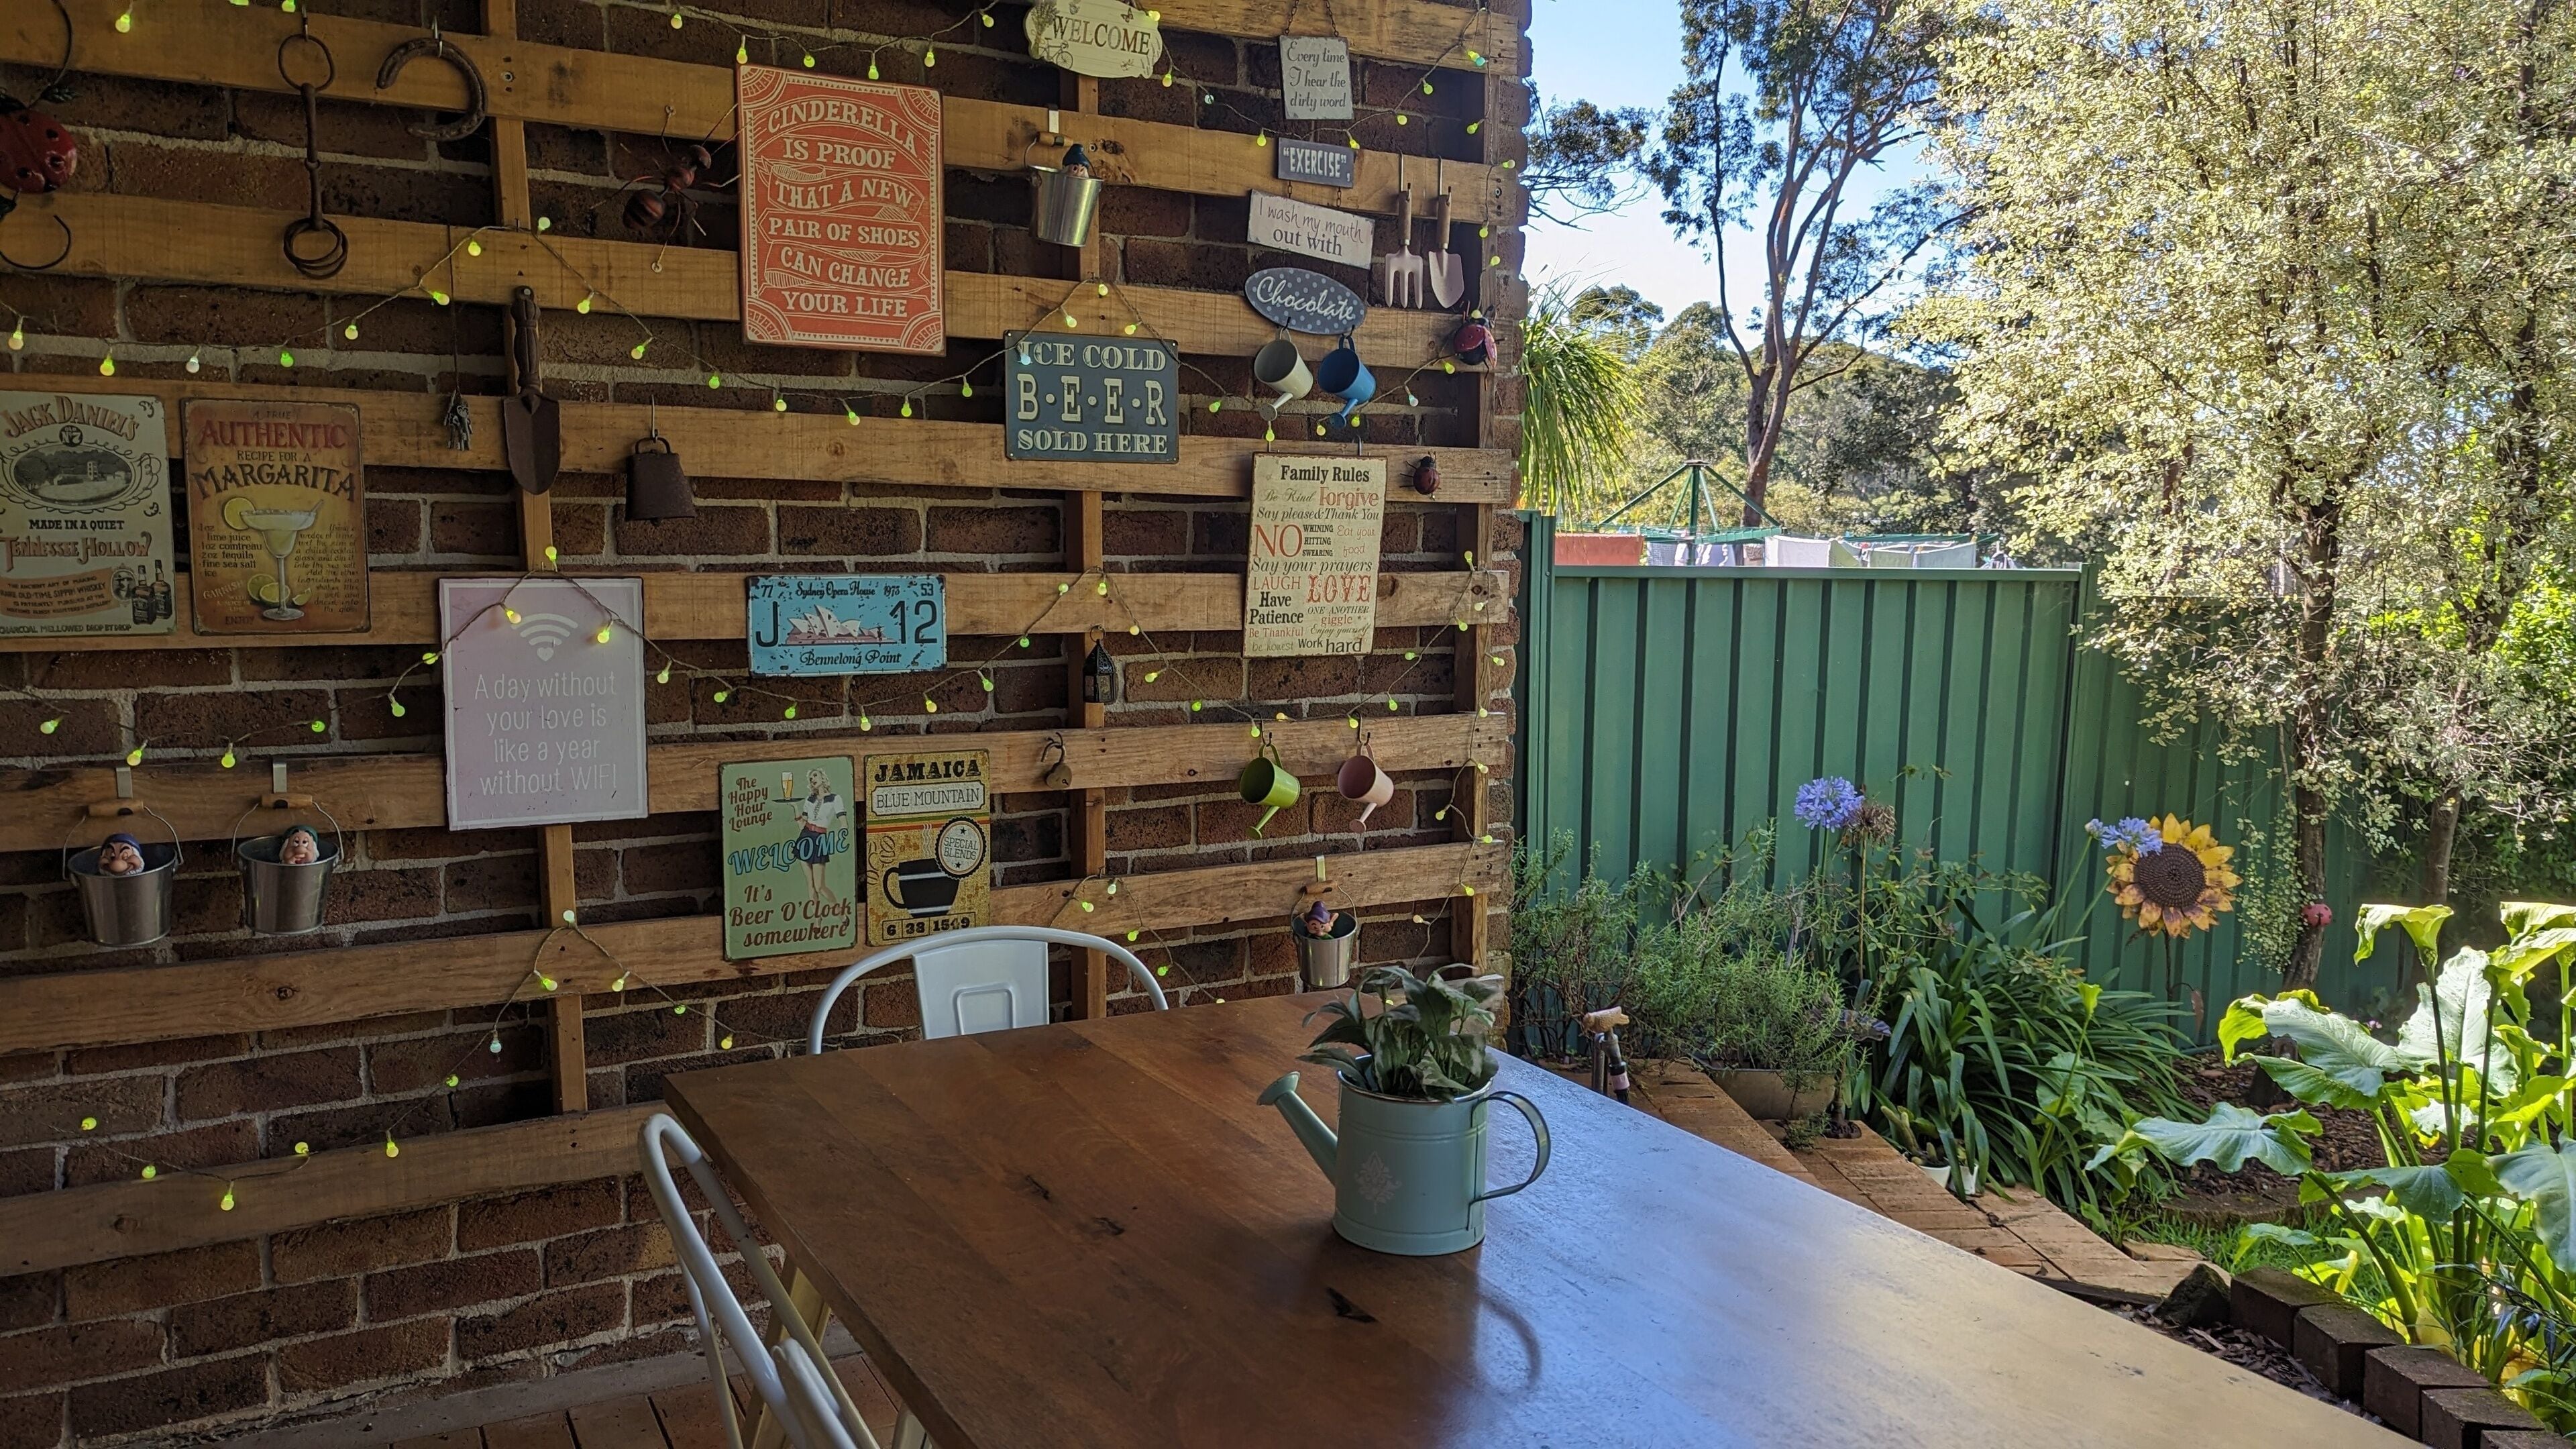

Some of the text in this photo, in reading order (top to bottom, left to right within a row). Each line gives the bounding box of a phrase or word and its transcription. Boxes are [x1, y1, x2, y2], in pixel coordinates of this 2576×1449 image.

[1053, 15, 1150, 55] WELCOME
[1287, 41, 1345, 67] Every time
[1289, 66, 1346, 88] I hear the
[1291, 92, 1346, 112] dirty word
[768, 99, 918, 158] CINDERELLA
[783, 138, 896, 169] IS PROOF
[775, 178, 915, 209] THAT A NEW
[1259, 197, 1364, 244] I wash my mouth
[768, 217, 920, 248] PAIR OF SHOES
[1273, 229, 1343, 256] out with
[781, 246, 911, 288] CAN CHANGE
[781, 290, 908, 317] YOUR LIFE
[1256, 276, 1354, 321] Chocolate
[1016, 341, 1167, 371] ICE COLD
[0, 402, 57, 438] JACK
[266, 411, 292, 419] TRUE
[199, 419, 347, 449] AUTHENTIC
[1018, 429, 1168, 454] SOLD HERE
[237, 450, 311, 463] RECIPE FOR A
[191, 464, 356, 502] MARGARITA
[1281, 465, 1370, 484] Family Rules
[1258, 488, 1317, 502] Be Kind
[1320, 487, 1379, 510] Forgive
[1257, 506, 1279, 521] Say
[1362, 508, 1380, 521] You
[29, 519, 125, 531] MADE IN A QUIET
[1303, 525, 1334, 533] WHINING
[1336, 525, 1376, 541] Eat your
[207, 533, 251, 542] lime juice
[1252, 524, 1303, 557] NO
[1303, 537, 1332, 545] HITTING
[222, 550, 254, 561] tequila
[1302, 549, 1333, 557] SWEARING
[203, 559, 220, 568] fine
[240, 560, 256, 568] salt
[1252, 557, 1373, 576] Say your prayers
[796, 581, 900, 599] Sydney Opera House 1973
[920, 583, 934, 596] 53
[1253, 576, 1301, 591] LAUGH
[1307, 574, 1371, 603] LOVE
[1259, 591, 1291, 607] Have
[1248, 608, 1304, 625] Patience
[1307, 606, 1369, 614] ONE ANOTHER
[755, 601, 779, 647] J
[889, 600, 937, 645] 12
[1321, 614, 1353, 627] giggle
[1249, 627, 1303, 637] Be Thankful
[1310, 624, 1334, 638] Enjoy
[1252, 641, 1263, 652] be
[1298, 638, 1362, 653] Work hard
[799, 649, 902, 669] Bennelong Point
[475, 672, 616, 703] A day without
[487, 703, 606, 737] your love is
[494, 739, 600, 765] like a year
[480, 763, 616, 796] without WIFI
[875, 759, 981, 783] JAMAICA
[736, 777, 757, 792] The
[728, 787, 769, 806] Happy
[876, 788, 981, 809] BLUE MOUNTAIN
[735, 801, 766, 818] Hour
[729, 810, 773, 833] Lounge
[728, 828, 851, 875] WELCOME
[943, 837, 979, 851] SPECIAL
[943, 847, 977, 861] BLENDS
[745, 884, 773, 904] It's
[729, 898, 852, 927] Beer O'Clock
[743, 924, 847, 947] somewhere
[887, 924, 897, 936] 6
